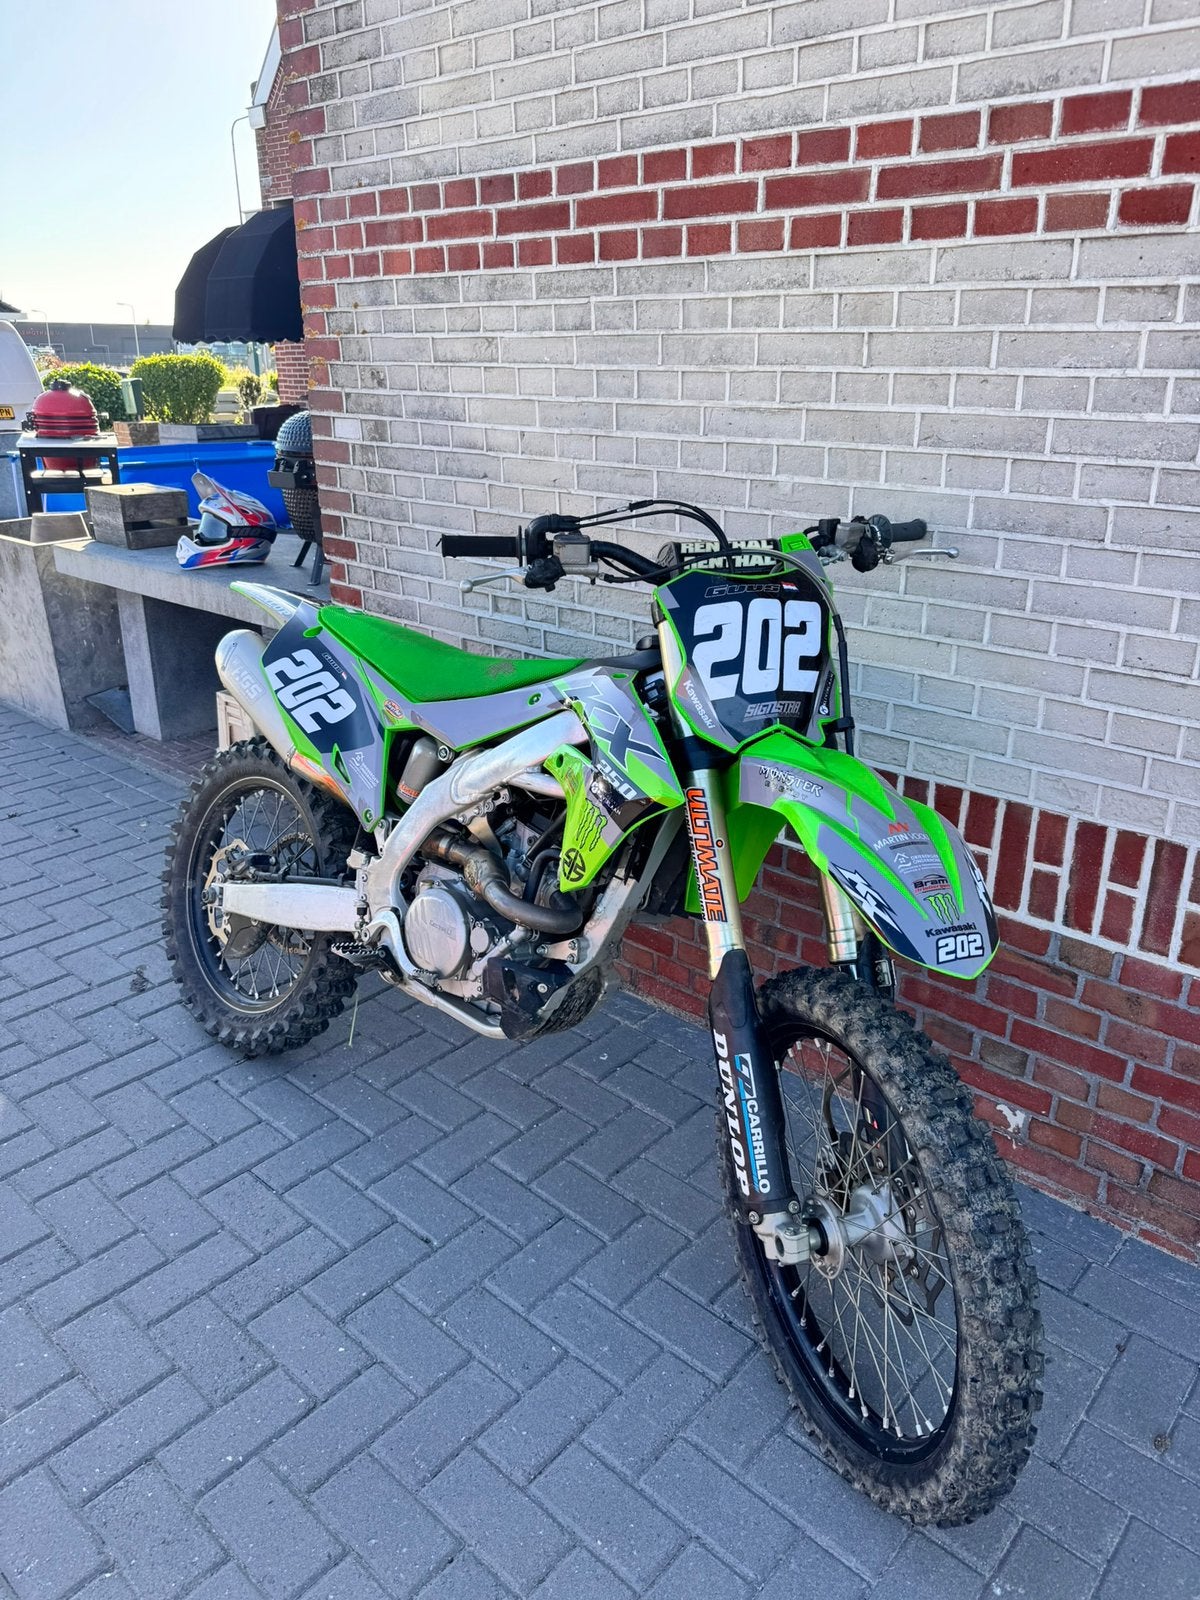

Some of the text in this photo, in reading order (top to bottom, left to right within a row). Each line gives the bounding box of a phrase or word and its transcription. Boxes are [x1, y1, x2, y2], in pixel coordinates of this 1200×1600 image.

[681, 540, 773, 553] RENHAL
[692, 598, 822, 701] 202
[264, 649, 357, 734] 202
[682, 679, 716, 729] Kawasaki
[596, 759, 637, 800] 250
[759, 765, 823, 797] MONSTER
[686, 787, 728, 922] ULTIMATE
[873, 833, 908, 851] MARTIN
[914, 879, 949, 889] Bram
[925, 922, 977, 938] Kawasaki
[936, 932, 985, 965] 202
[713, 1029, 750, 1197] DUNLOP
[746, 1100, 771, 1194] CARRILLO
